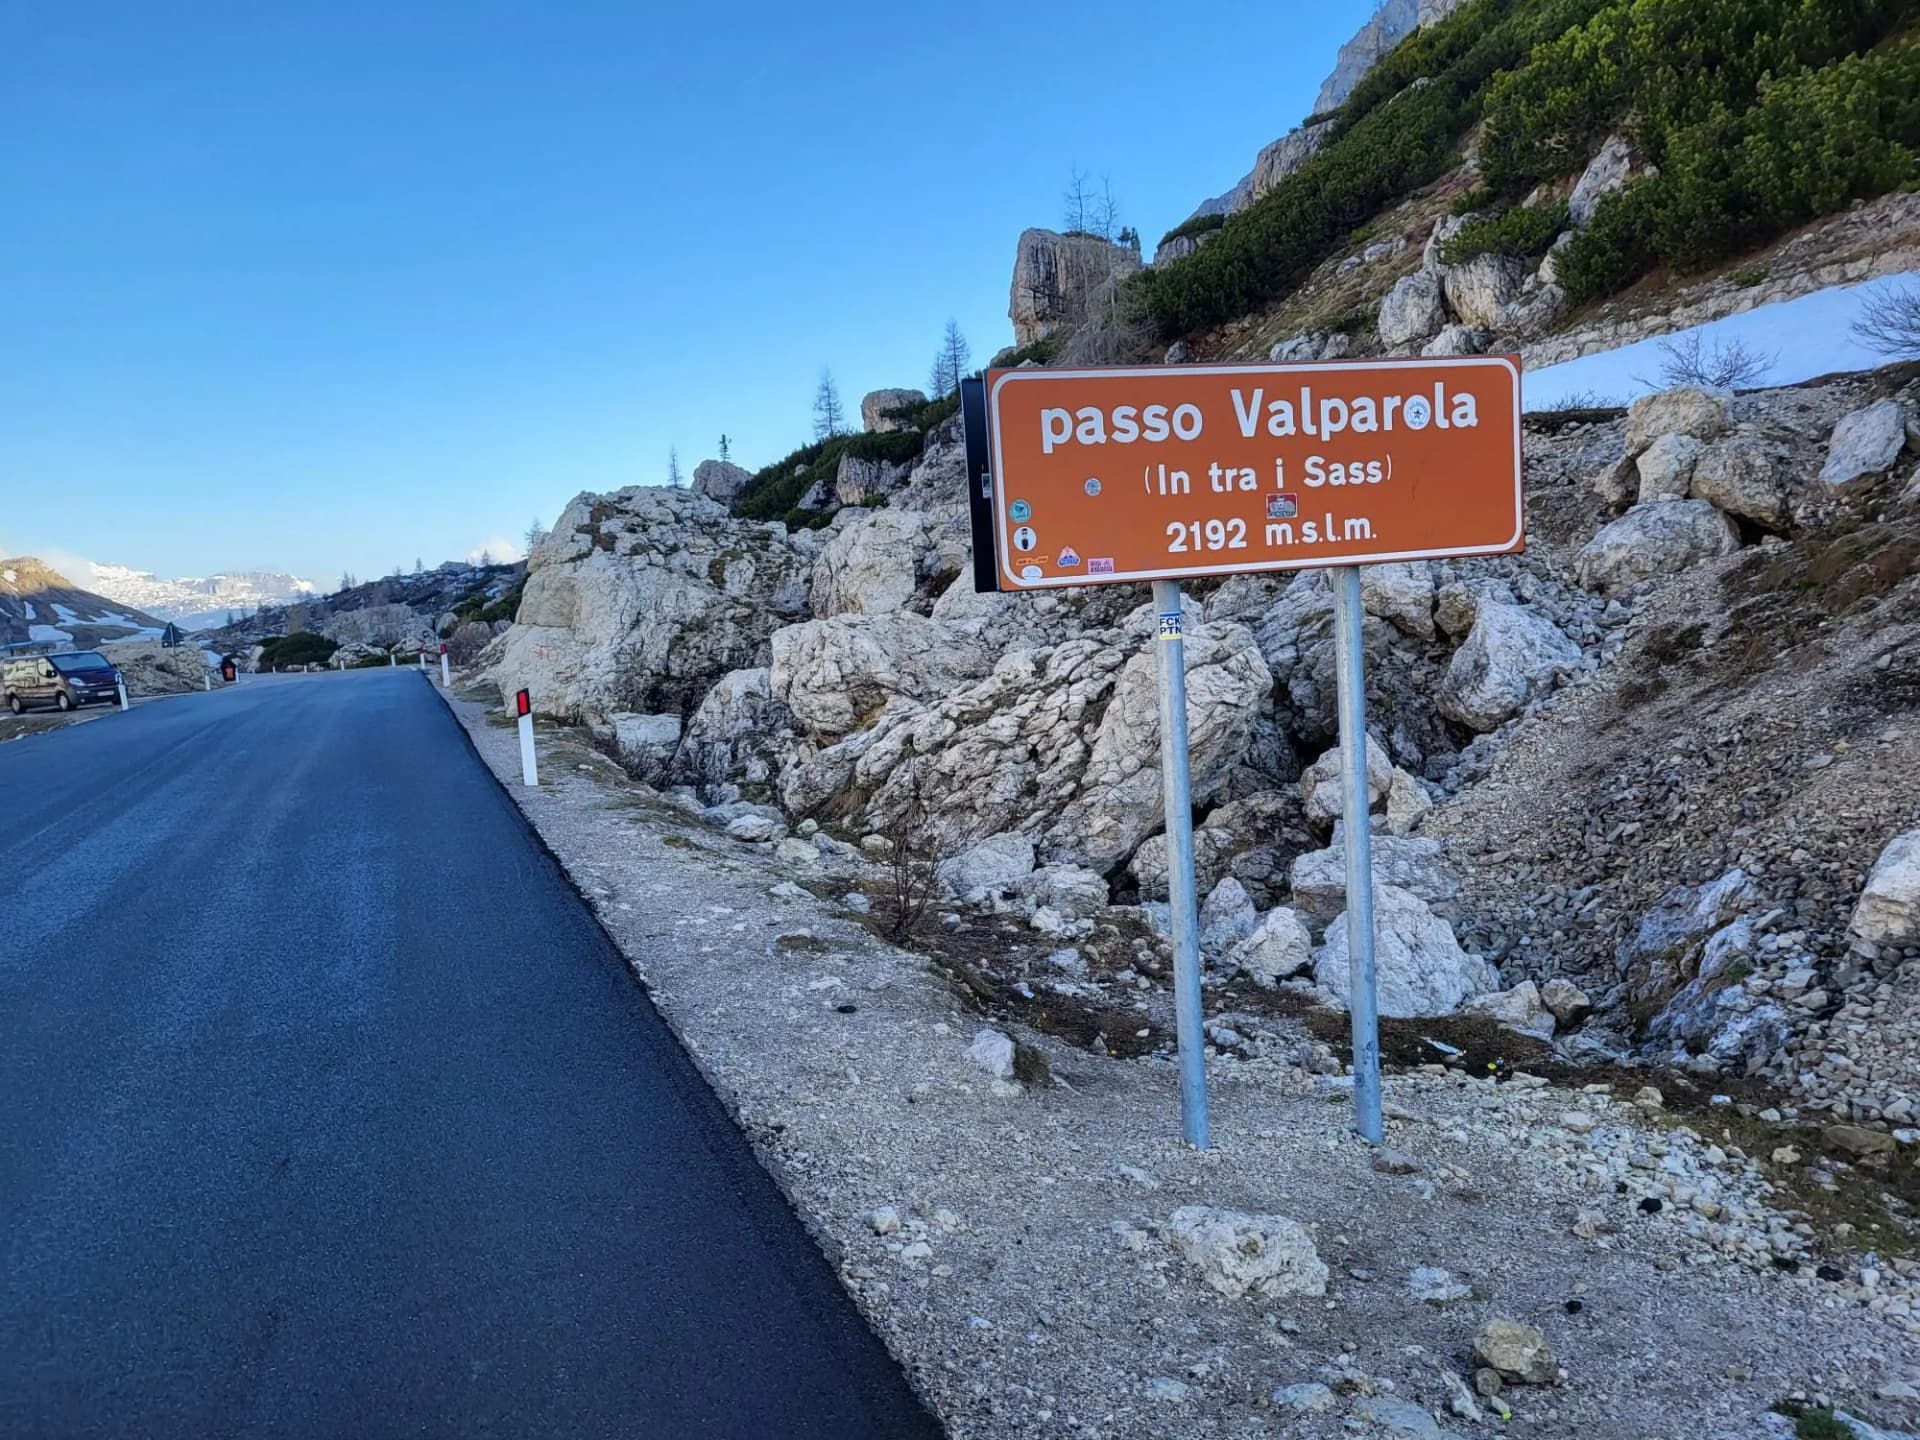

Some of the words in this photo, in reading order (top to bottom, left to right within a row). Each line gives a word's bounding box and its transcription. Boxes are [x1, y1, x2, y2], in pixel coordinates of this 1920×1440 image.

[1041, 403, 1202, 453] passo
[1231, 382, 1478, 441] Valparola
[1145, 463, 1190, 495] (In
[1209, 461, 1258, 493] tra
[1275, 458, 1285, 489] i
[1304, 454, 1392, 488] Sass)
[1166, 519, 1247, 552] 2192
[1266, 513, 1376, 545] m.s.l.m.
